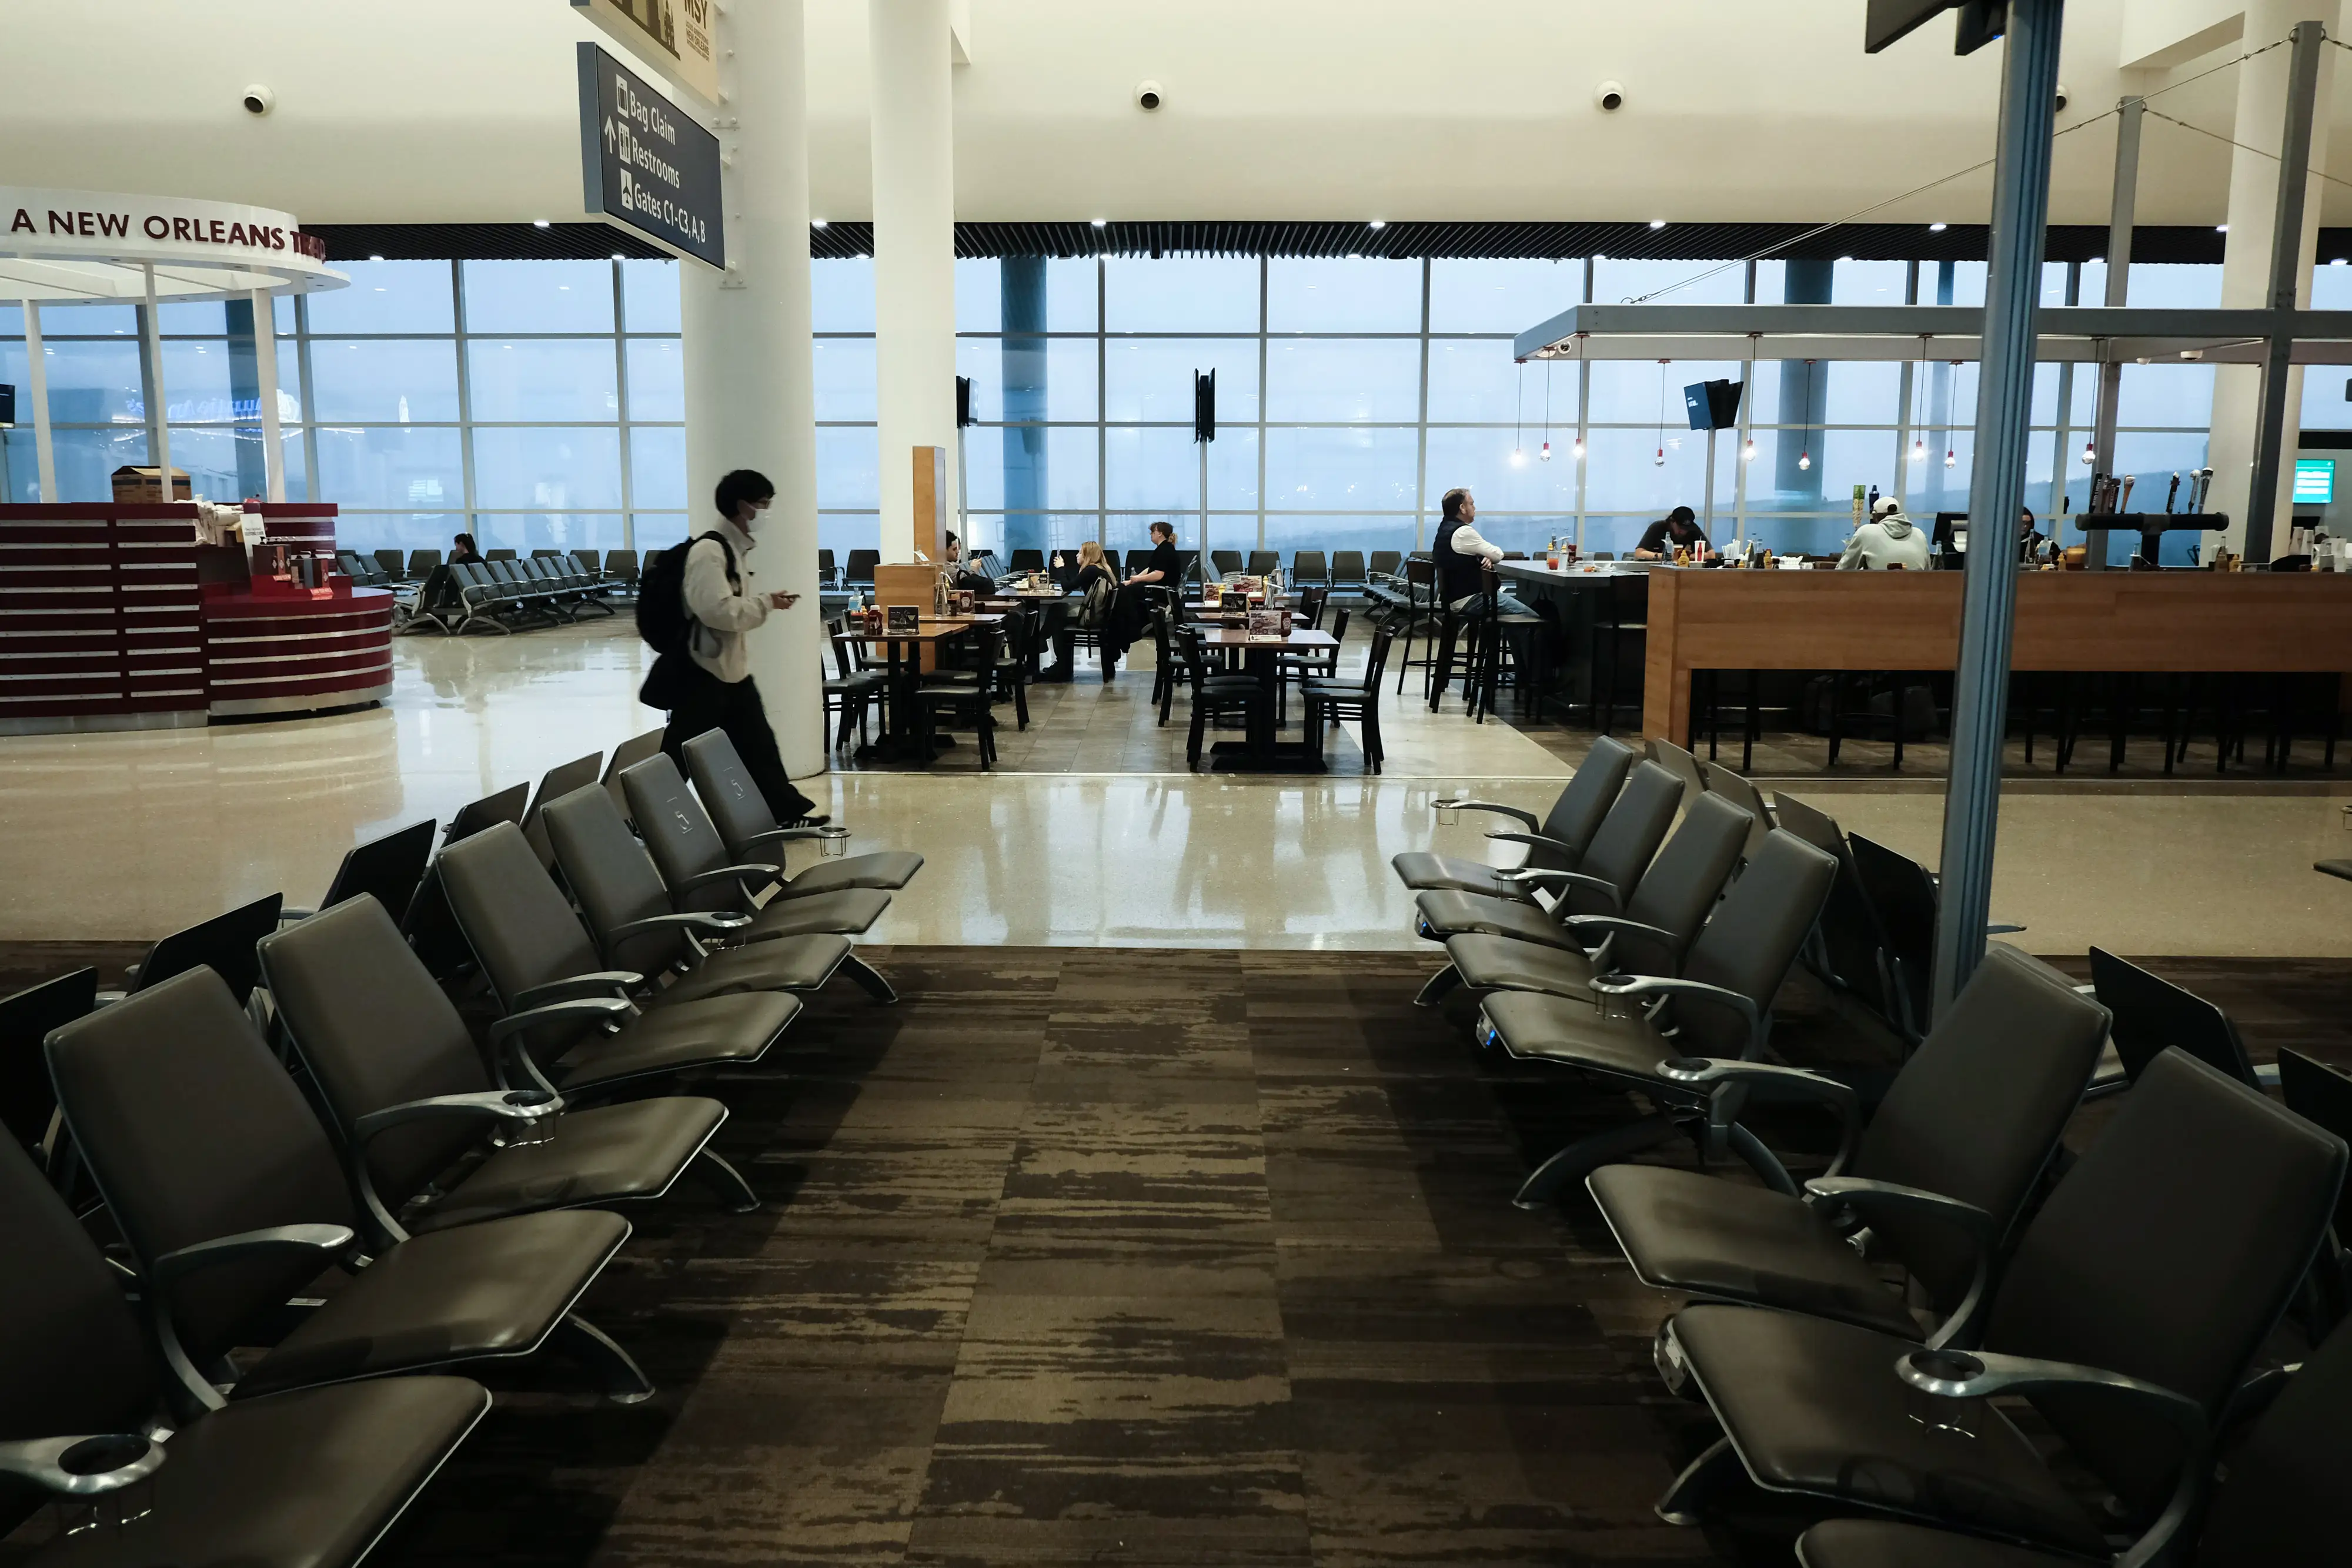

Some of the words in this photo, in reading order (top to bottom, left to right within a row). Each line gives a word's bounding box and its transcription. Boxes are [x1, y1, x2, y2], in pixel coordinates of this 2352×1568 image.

[684, 0, 707, 30] MSY
[630, 90, 647, 133] Bag
[651, 106, 676, 146] Claim
[632, 136, 680, 189] Restrooms
[634, 182, 662, 220] Gates
[11, 209, 36, 233] A
[48, 209, 129, 237] NEW
[143, 215, 285, 250] ORLEANS
